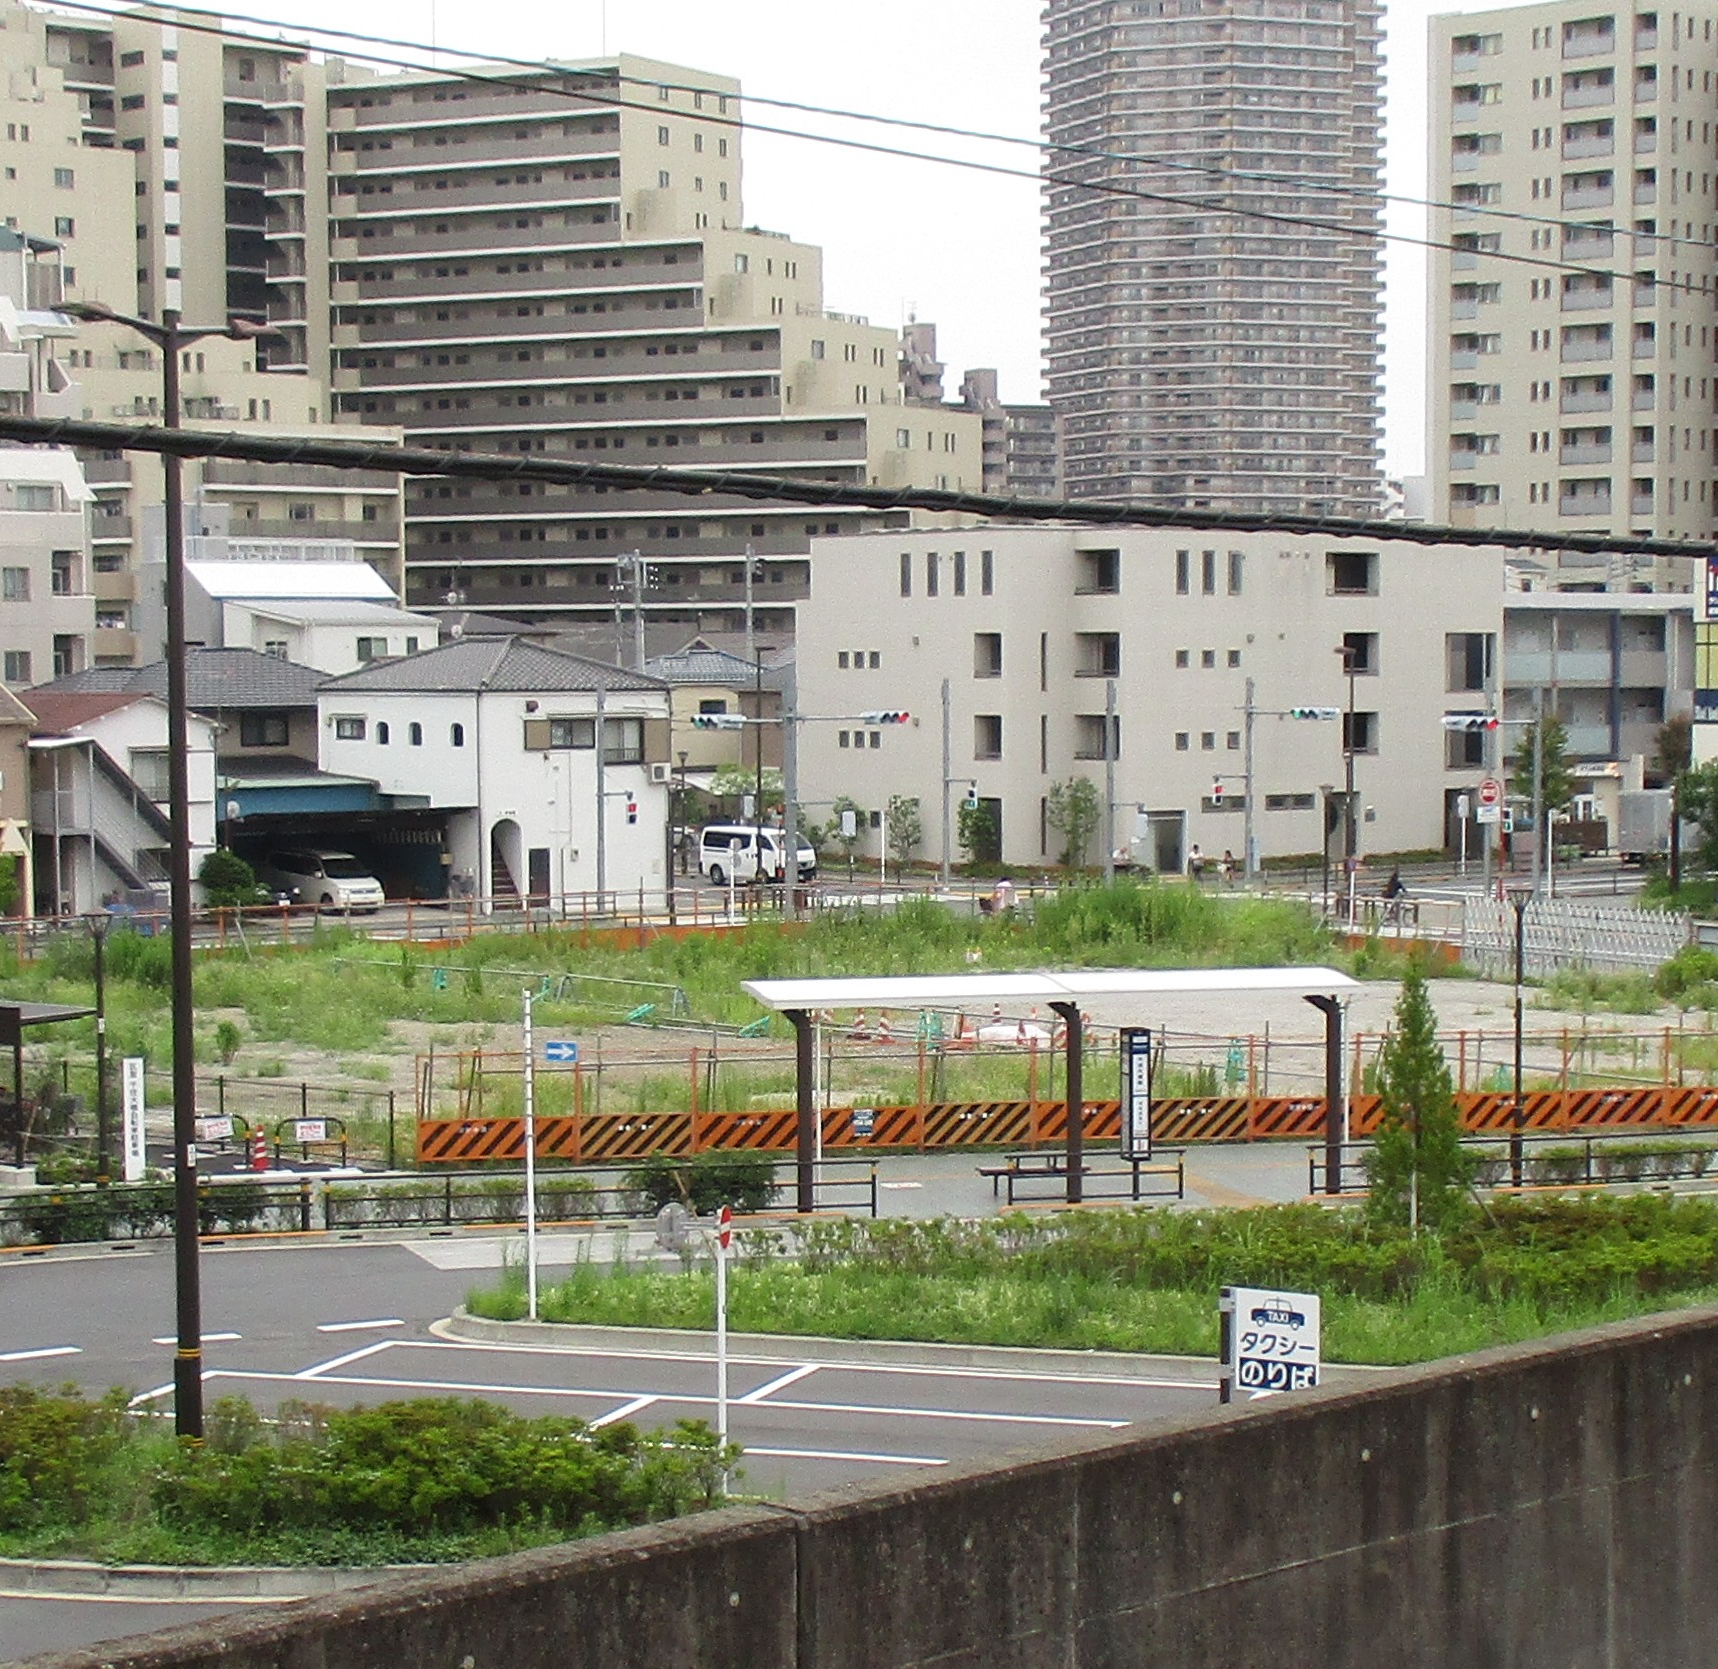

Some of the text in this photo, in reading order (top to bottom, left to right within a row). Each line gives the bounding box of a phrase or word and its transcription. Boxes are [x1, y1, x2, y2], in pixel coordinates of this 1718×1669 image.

[1268, 1311, 1289, 1323] TAXI
[1240, 1332, 1315, 1356] タクシー
[1242, 1361, 1315, 1390] のりば
